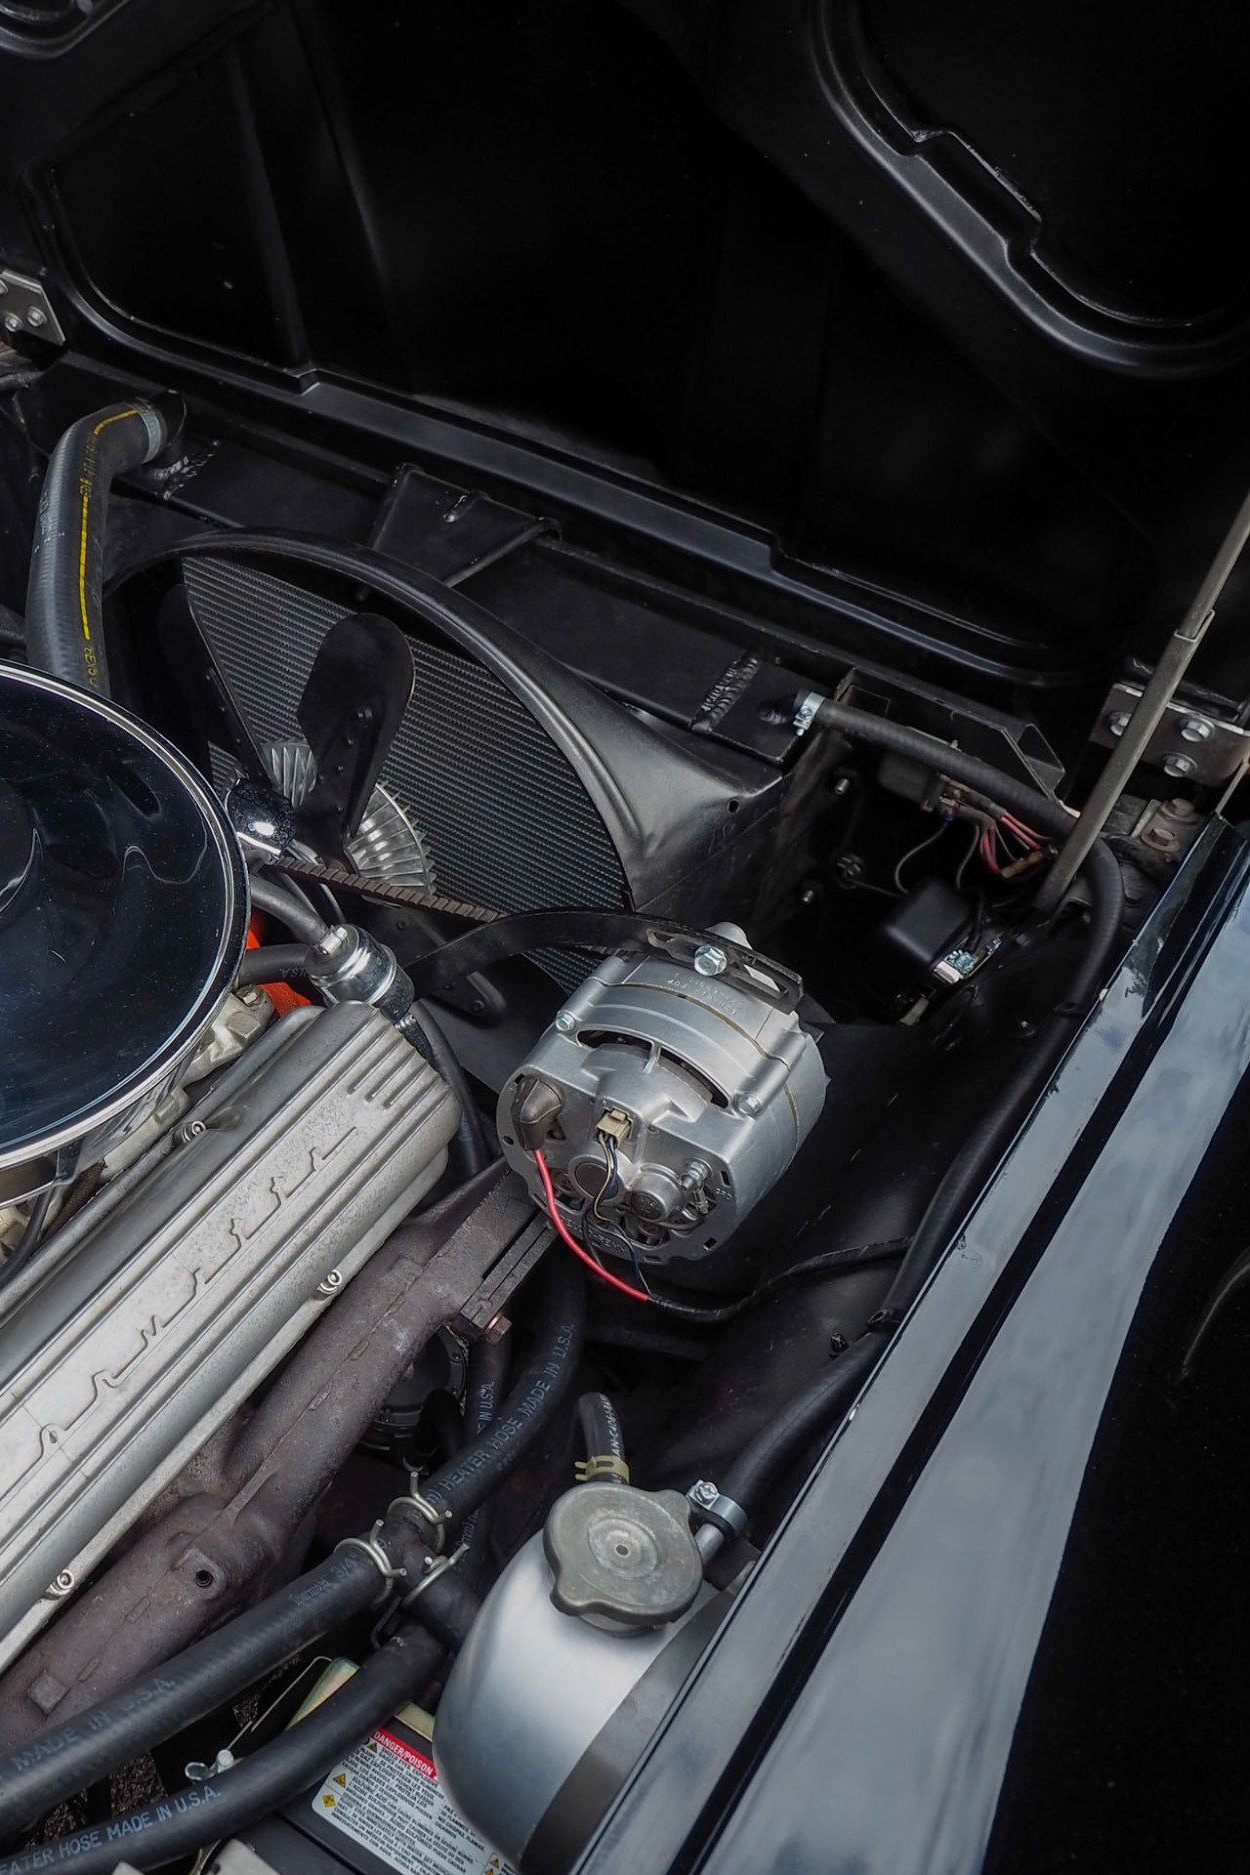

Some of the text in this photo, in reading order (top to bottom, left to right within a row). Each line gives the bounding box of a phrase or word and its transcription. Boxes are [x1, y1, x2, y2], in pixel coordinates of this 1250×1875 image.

[438, 1449, 491, 1491] HEATER
[487, 1417, 523, 1450] HOSE
[517, 1380, 550, 1417] MADE
[544, 1362, 560, 1378] IN
[10, 1729, 80, 1771] MADE
[89, 1711, 113, 1731] IN
[373, 1730, 434, 1775] DANGER/POISON
[59, 1831, 103, 1859] HOSE
[106, 1811, 154, 1841] MADE
[156, 1803, 174, 1821] IN
[175, 1782, 223, 1813] U.S.A.
